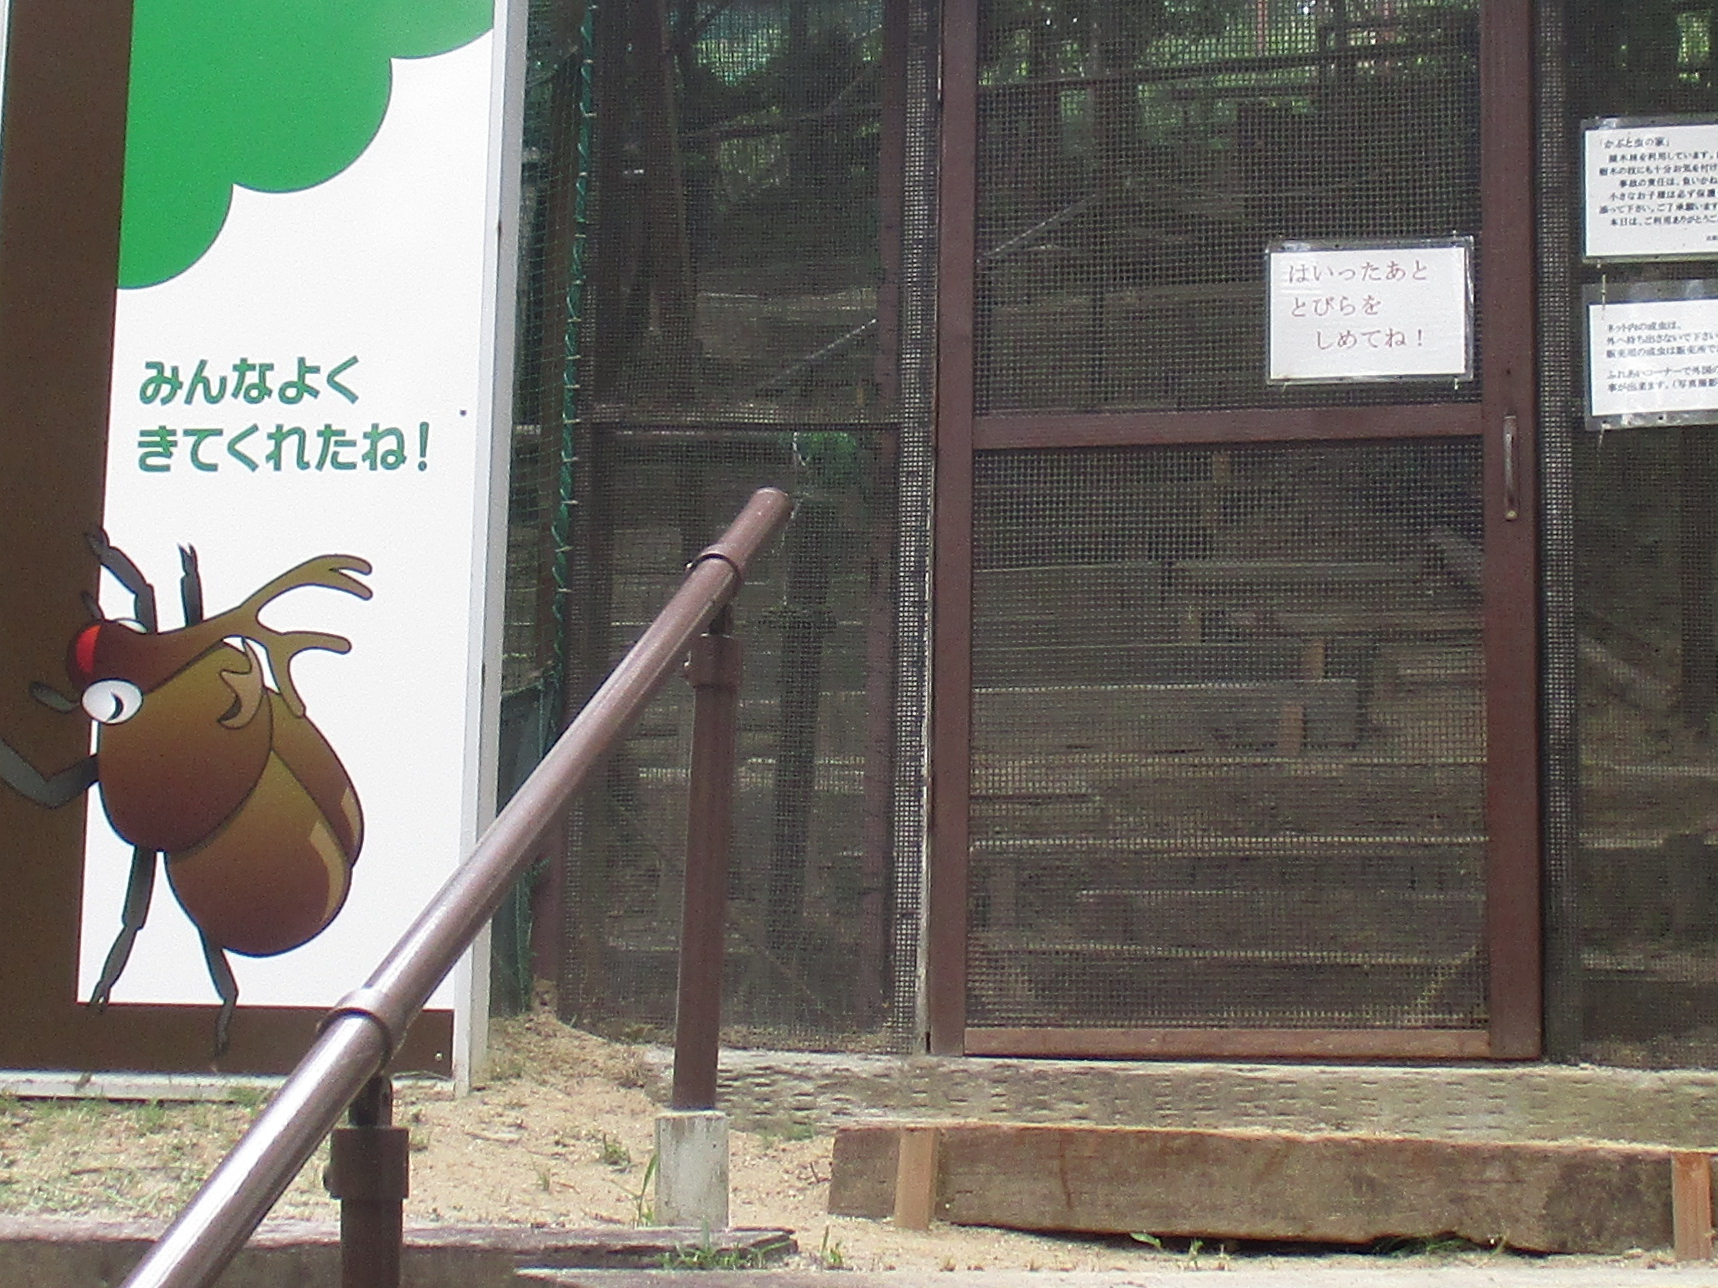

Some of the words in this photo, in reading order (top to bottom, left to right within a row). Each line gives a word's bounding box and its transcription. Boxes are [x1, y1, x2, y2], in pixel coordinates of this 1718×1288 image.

[1288, 260, 1428, 284] はいったあと
[1291, 295, 1382, 318] とびらを
[139, 355, 359, 406] みんなよく
